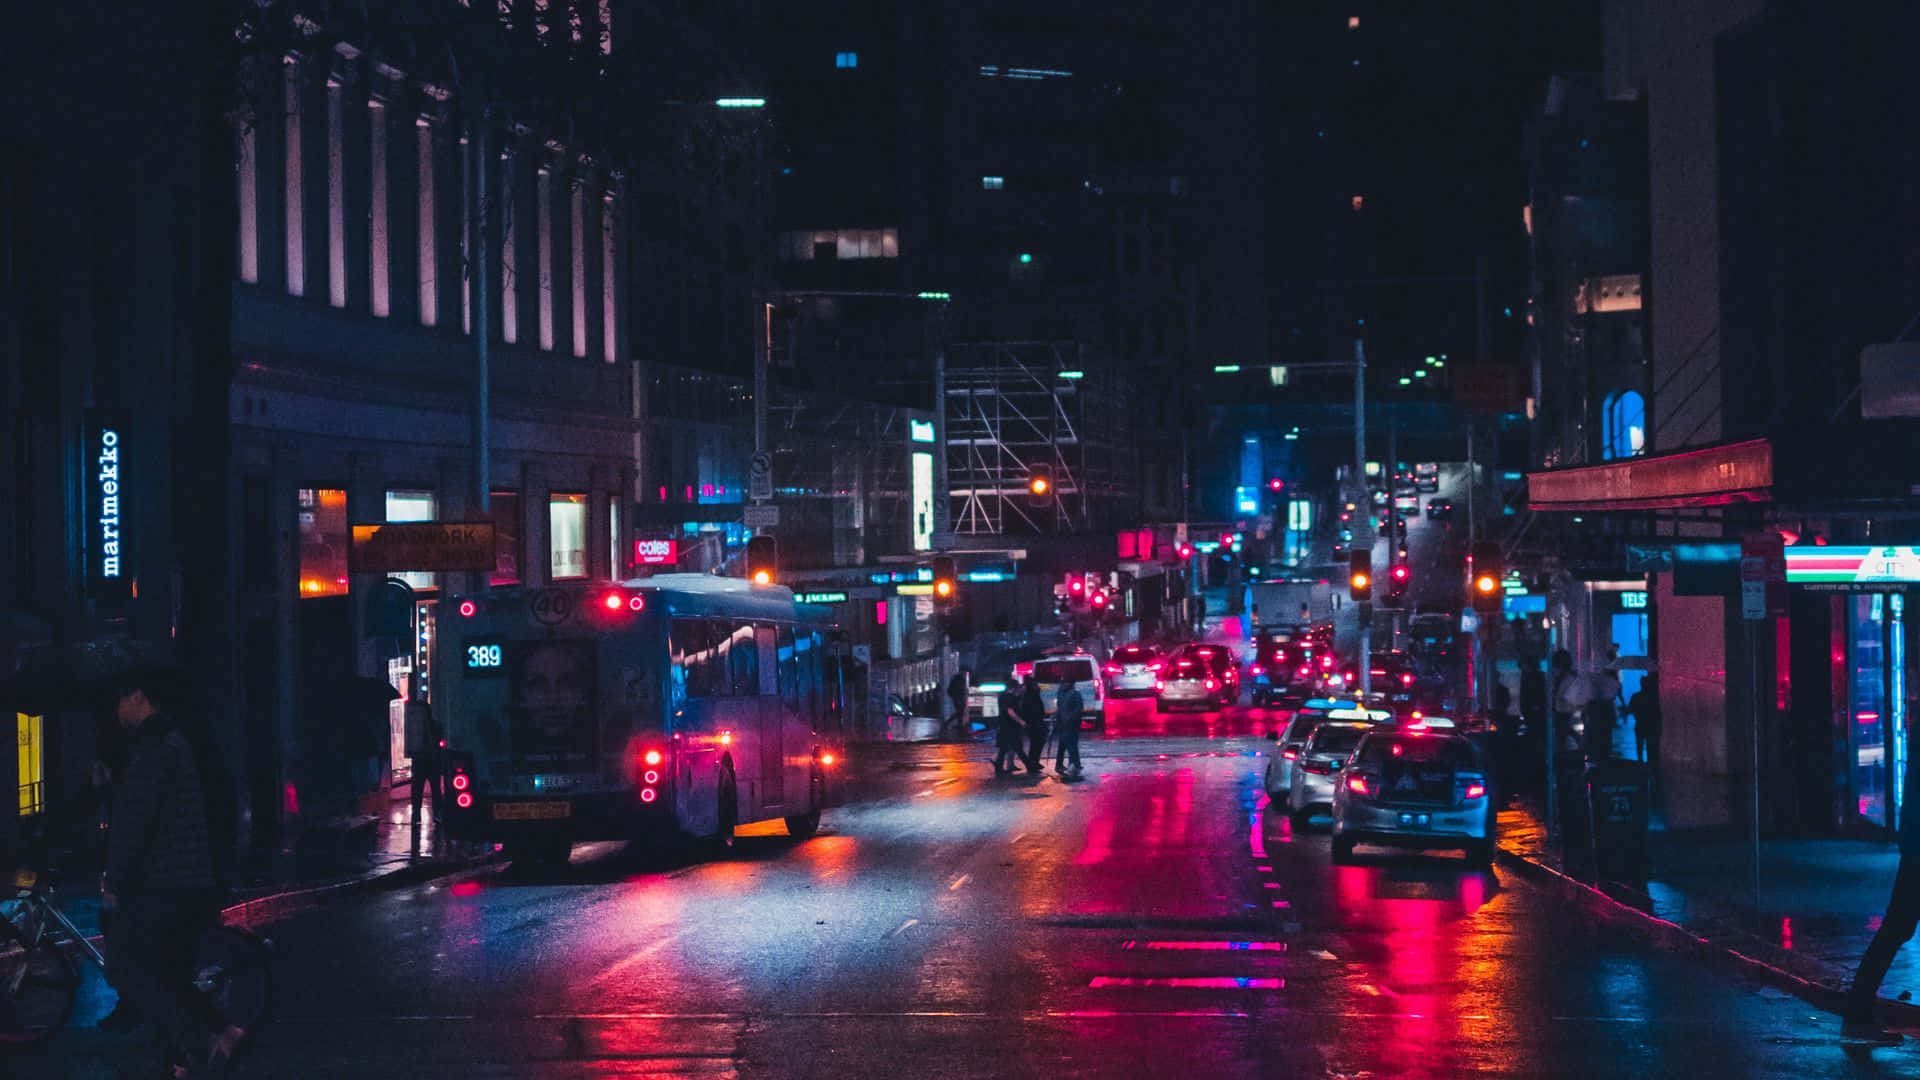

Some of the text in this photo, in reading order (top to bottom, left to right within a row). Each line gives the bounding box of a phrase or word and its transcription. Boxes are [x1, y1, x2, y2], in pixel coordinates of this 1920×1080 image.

[99, 431, 119, 577] marimekko
[371, 528, 476, 545] ROADWORK
[639, 540, 670, 555] coles
[467, 645, 502, 668] 389
